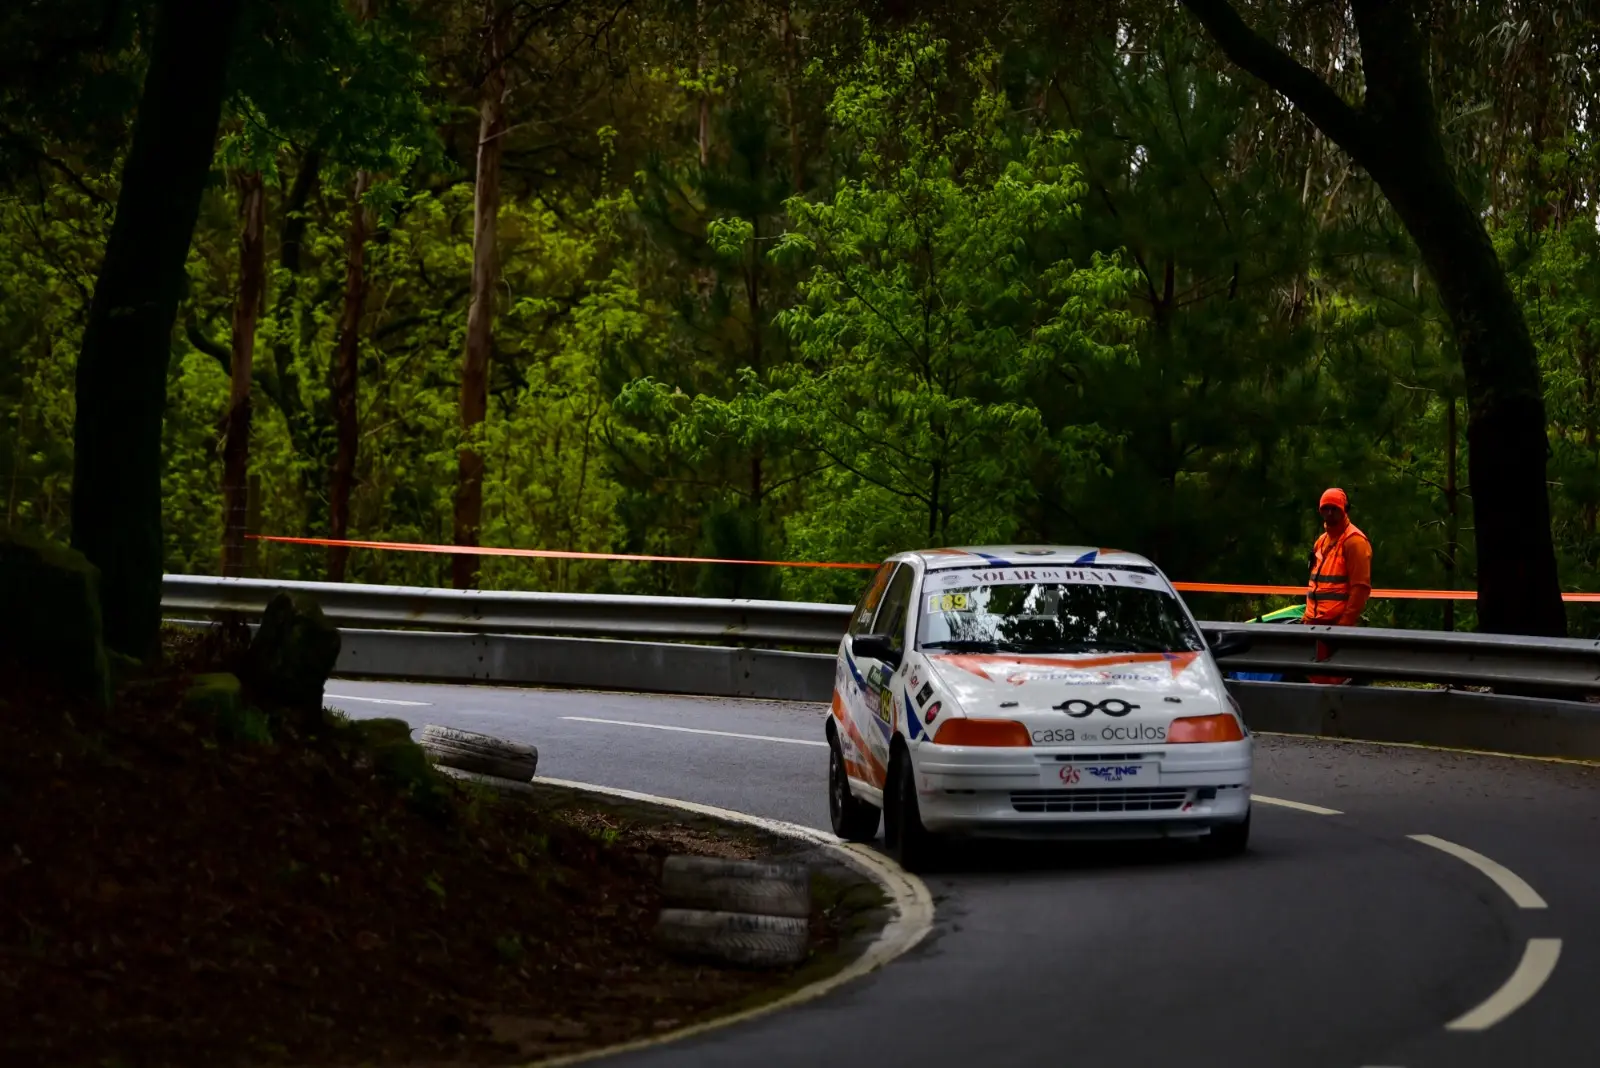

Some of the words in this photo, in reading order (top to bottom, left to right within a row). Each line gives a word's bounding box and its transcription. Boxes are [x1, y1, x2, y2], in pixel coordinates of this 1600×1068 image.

[972, 570, 1036, 583] SOLAR
[1066, 570, 1117, 583] PENA
[929, 594, 966, 611] 189
[1032, 728, 1075, 743] casa
[1080, 733, 1098, 742] dos
[1101, 723, 1166, 741] óculos
[1085, 766, 1142, 776] RACING
